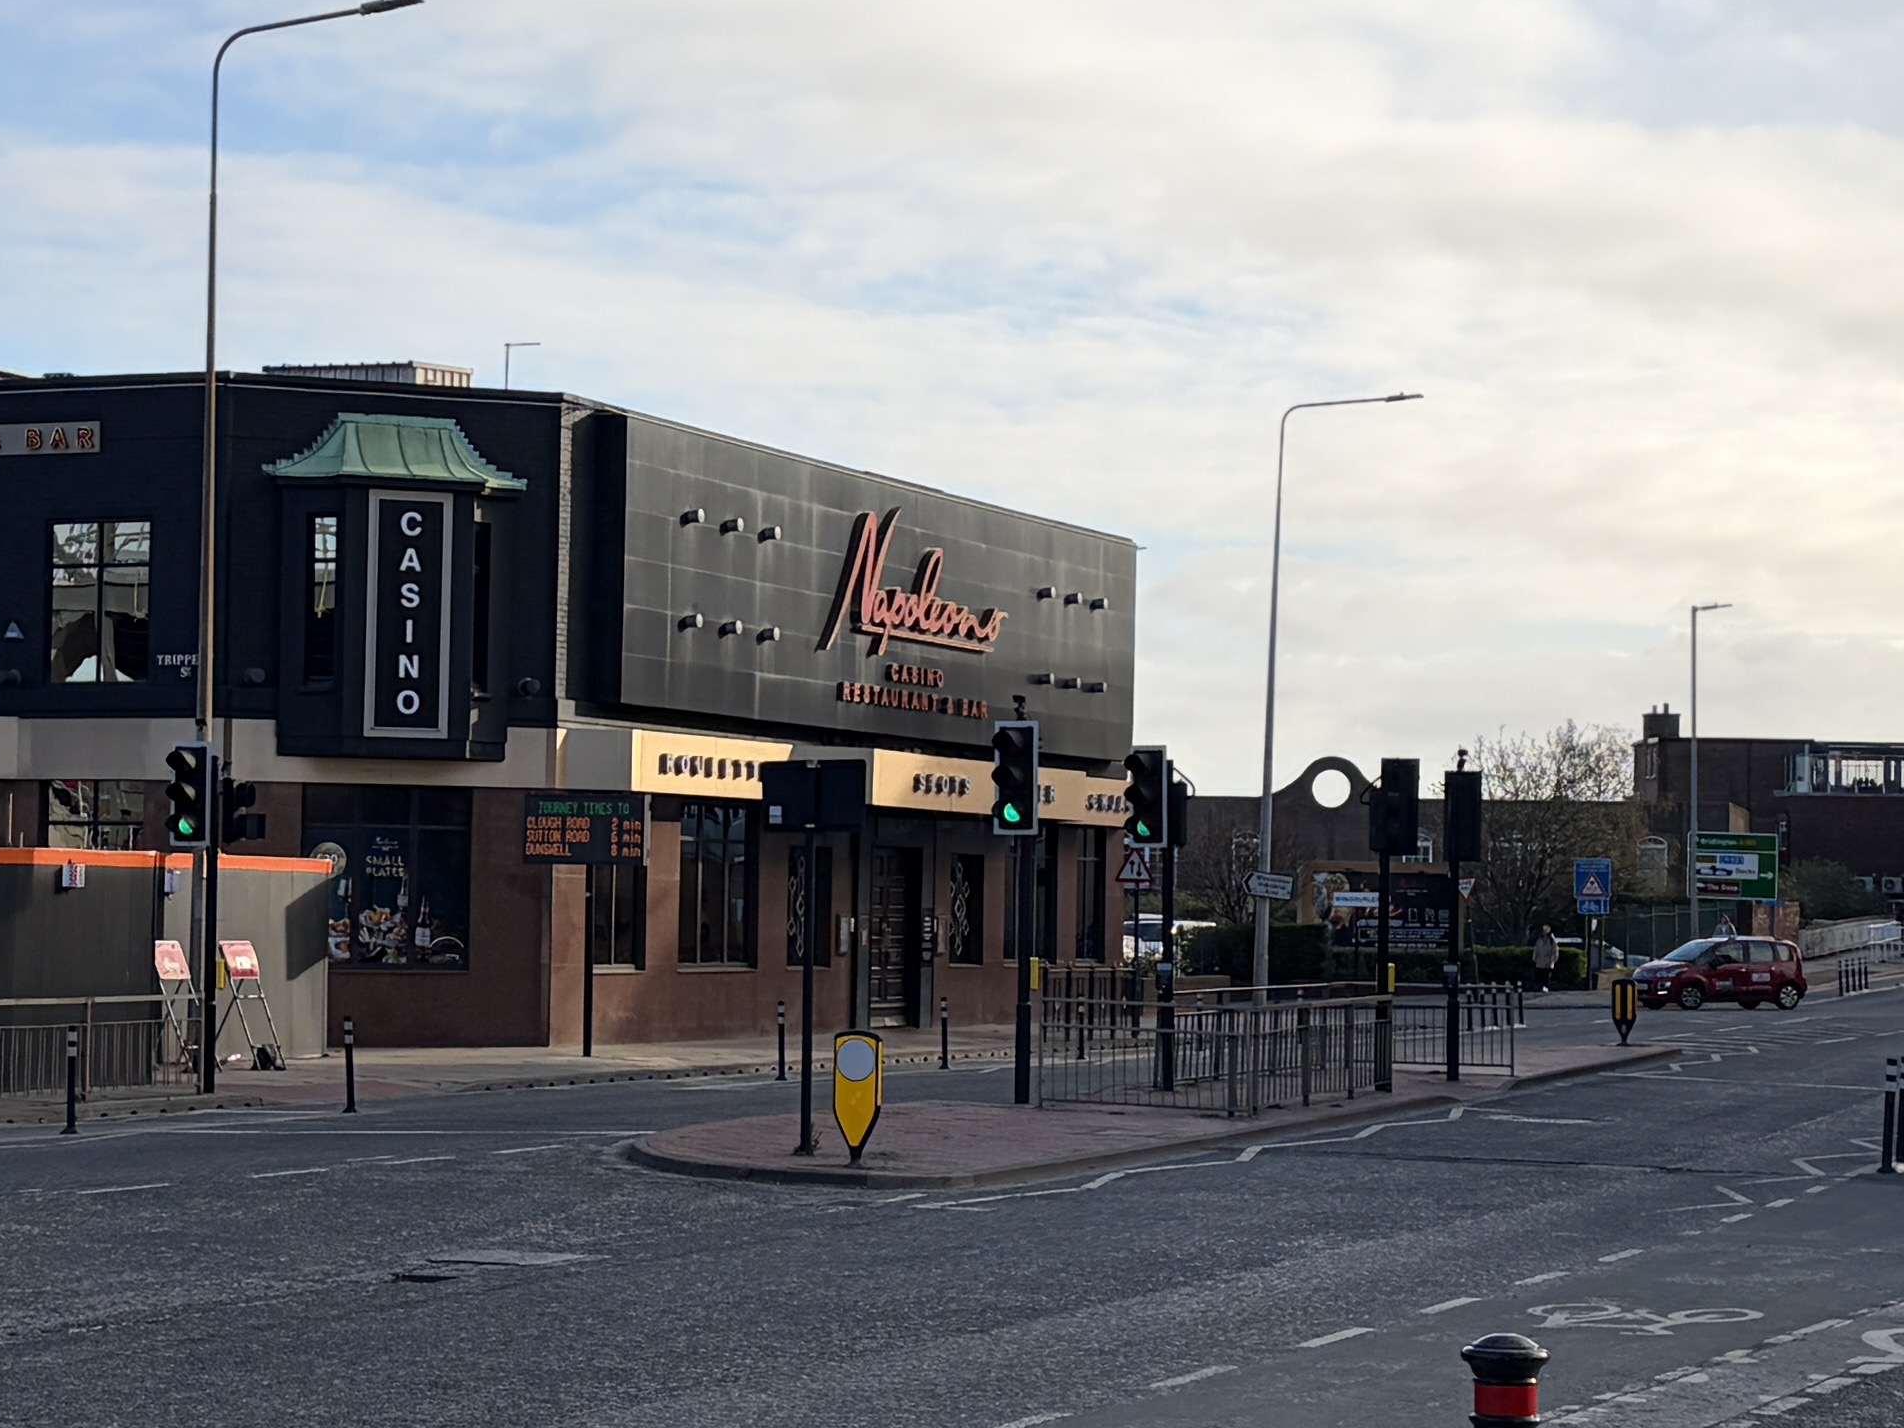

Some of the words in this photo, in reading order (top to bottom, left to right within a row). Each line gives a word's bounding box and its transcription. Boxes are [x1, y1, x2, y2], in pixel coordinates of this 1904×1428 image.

[26, 425, 95, 451] BAR
[818, 507, 1009, 657] Napoleons
[396, 511, 423, 715] CASINO
[157, 654, 200, 666] TRIPPE
[888, 663, 944, 688] CASINO
[841, 681, 940, 713] RESTAURANT
[961, 698, 989, 719] BAR
[658, 753, 762, 782] ROULETT
[618, 803, 630, 815] TO
[526, 816, 562, 829] CLOUGH
[566, 817, 591, 830] ROAD
[623, 818, 642, 831] min
[526, 830, 562, 842] SUTTON
[566, 830, 591, 843] ROAD
[622, 832, 642, 844] min
[622, 845, 641, 857] min
